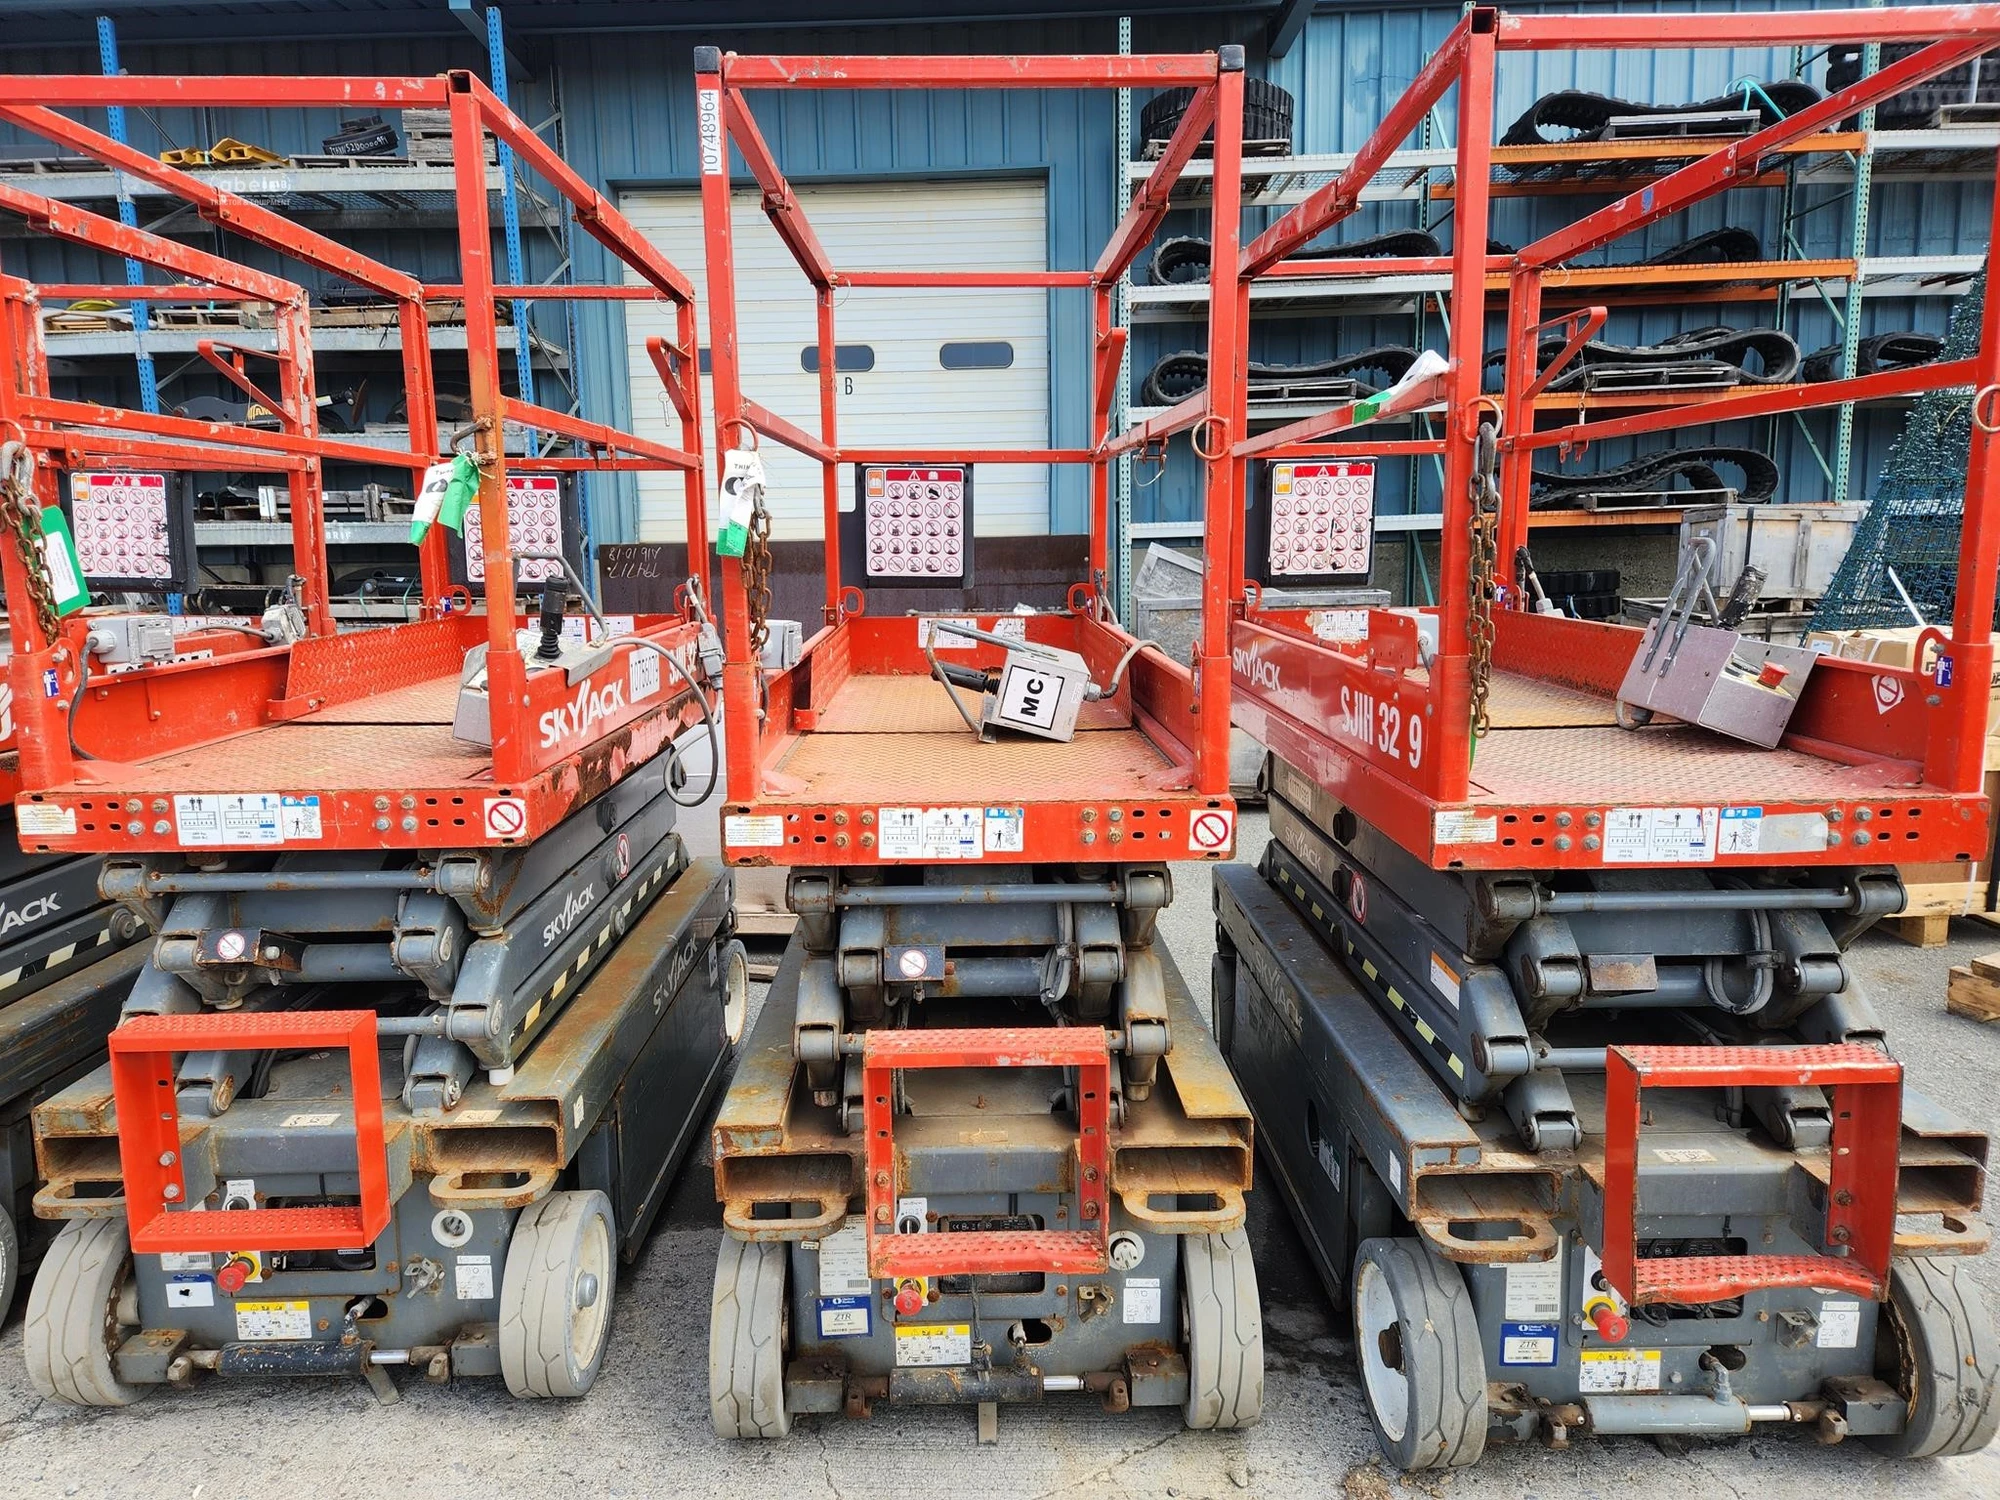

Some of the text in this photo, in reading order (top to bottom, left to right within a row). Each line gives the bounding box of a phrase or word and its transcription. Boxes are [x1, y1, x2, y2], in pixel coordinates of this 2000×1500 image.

[701, 91, 717, 172] 10748964
[844, 376, 853, 395] B
[1232, 641, 1281, 692] SKYJACK
[539, 679, 625, 748] SKYJACK
[1020, 678, 1044, 717] MC
[1285, 826, 1322, 874] SKYJACK
[543, 883, 595, 948] SKYJACK
